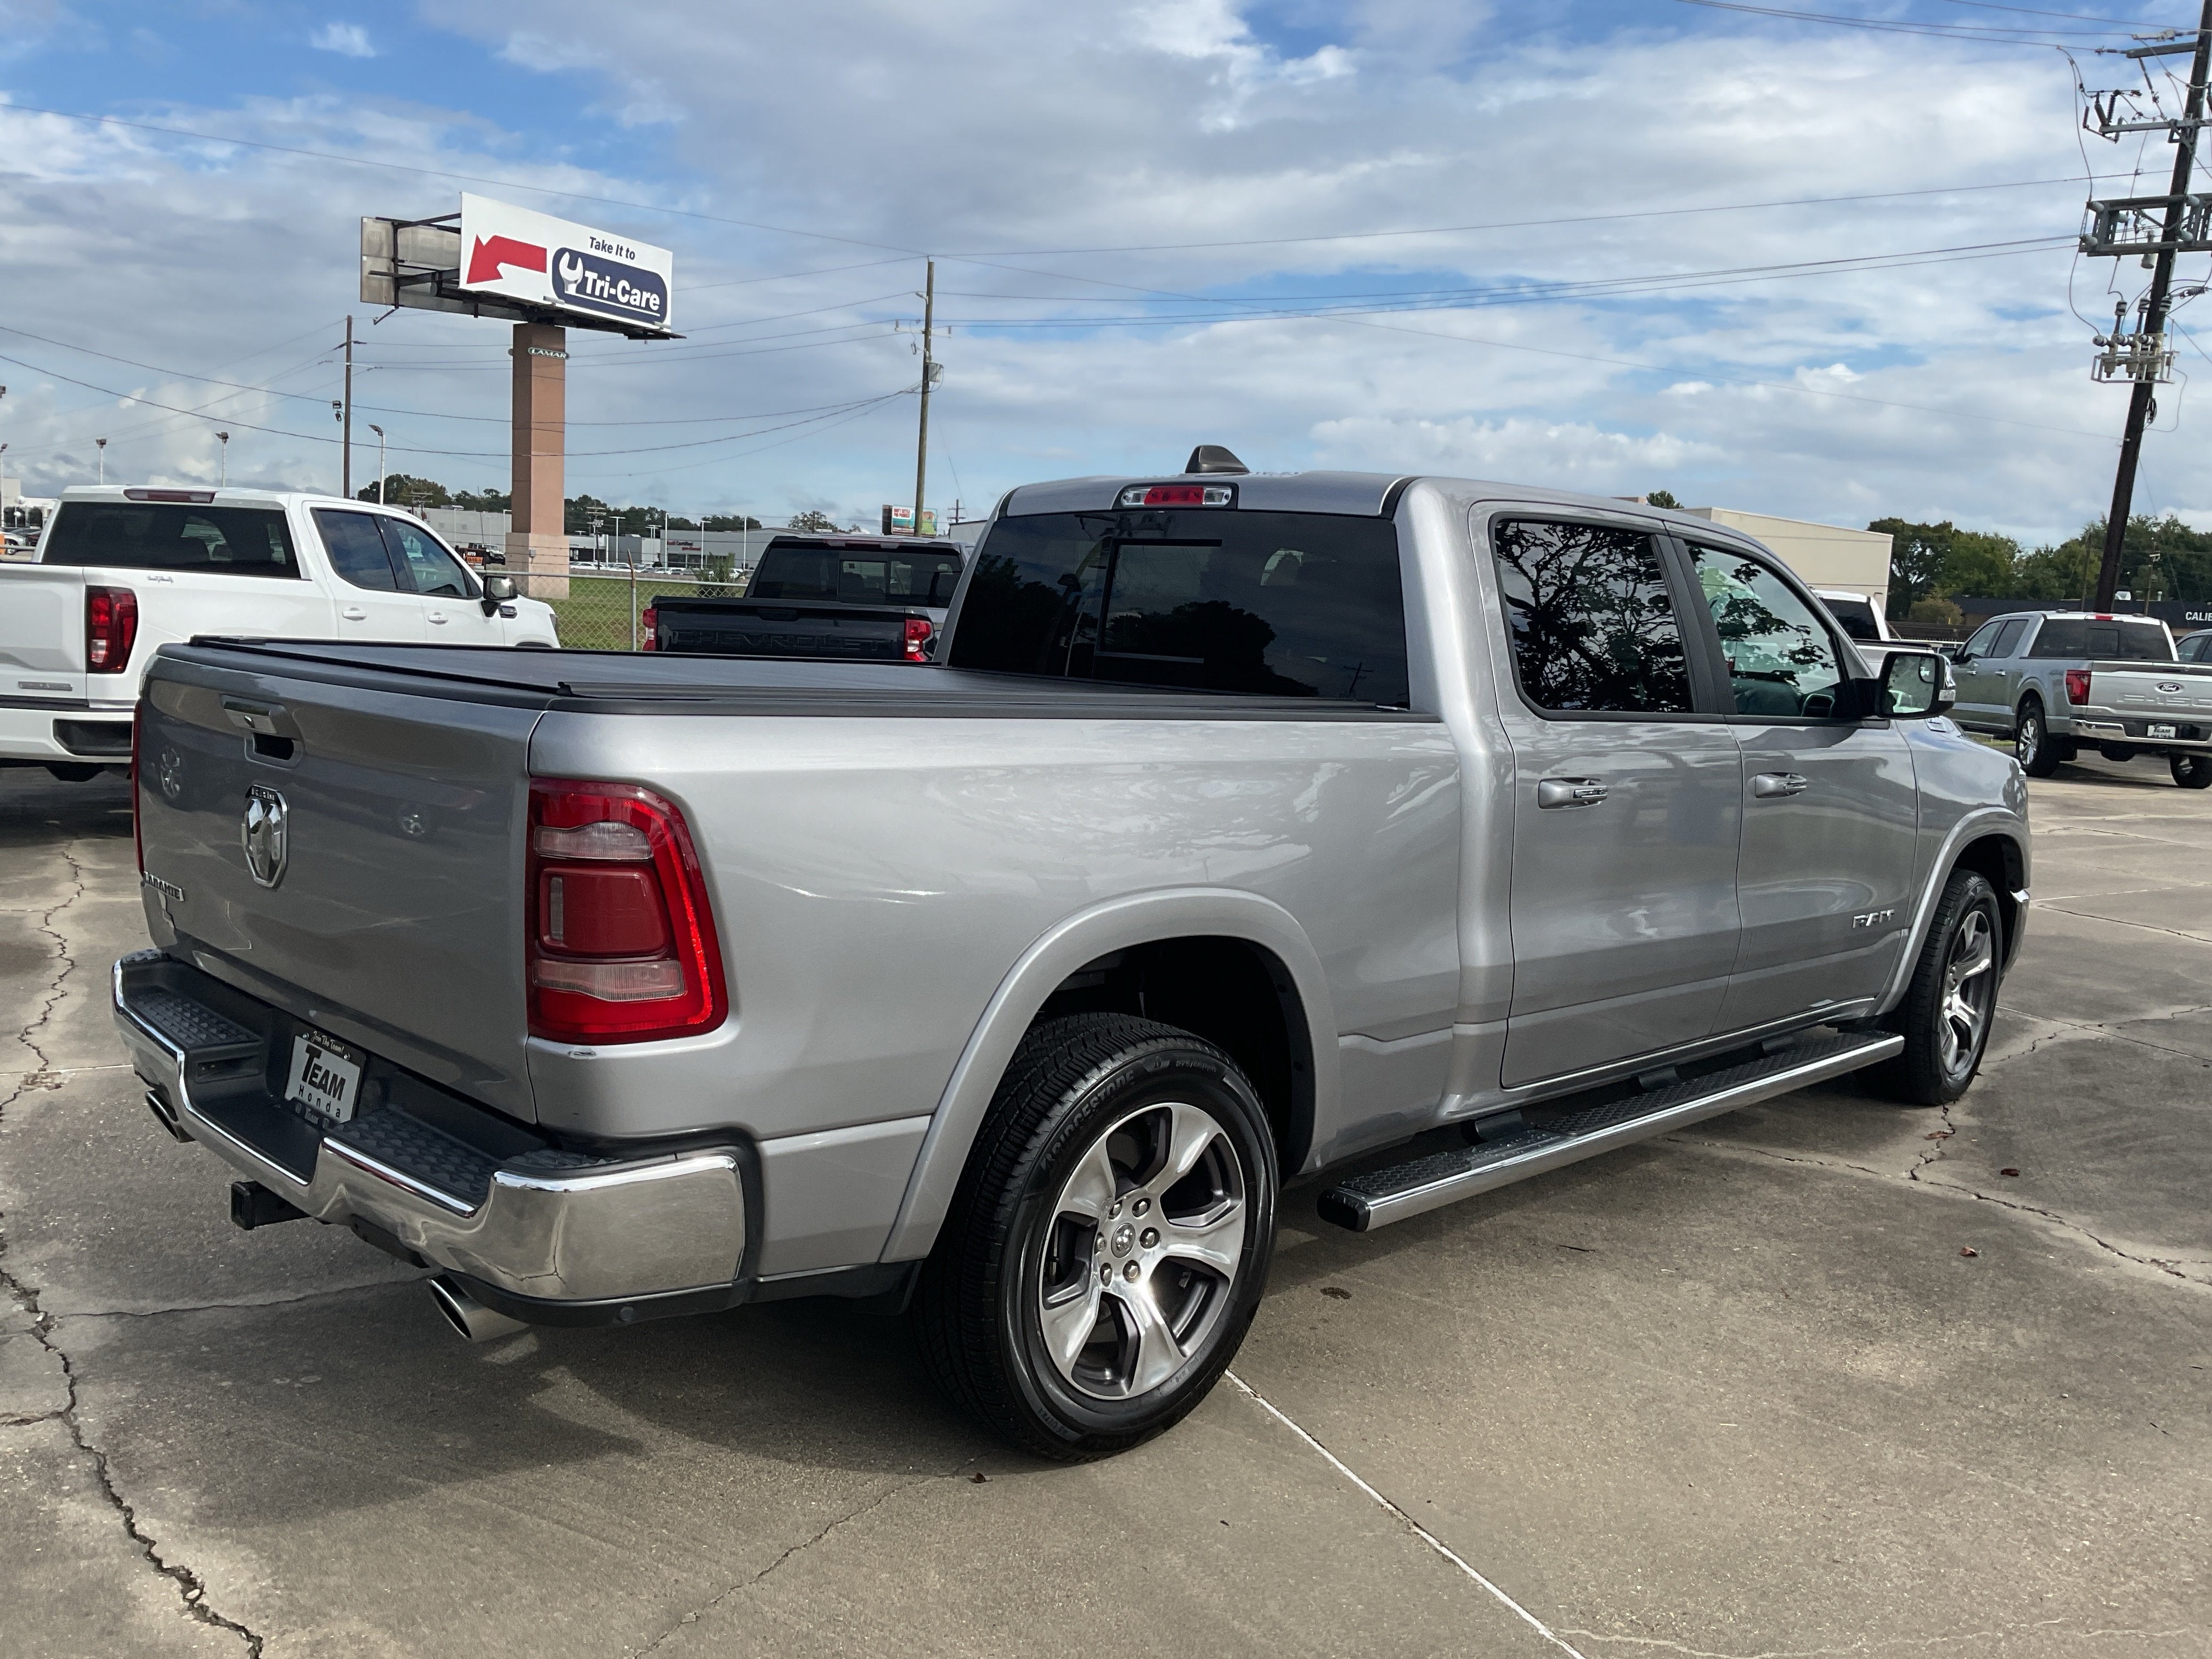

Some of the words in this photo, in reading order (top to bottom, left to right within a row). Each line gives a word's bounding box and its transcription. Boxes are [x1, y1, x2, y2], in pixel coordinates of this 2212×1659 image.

[590, 236, 613, 253] Take
[616, 244, 624, 257] It
[625, 247, 635, 260] to
[585, 270, 660, 311] Tri-Care
[531, 349, 567, 358] LAMAR
[302, 1043, 346, 1102] TEAM
[298, 1084, 341, 1119] Honda
